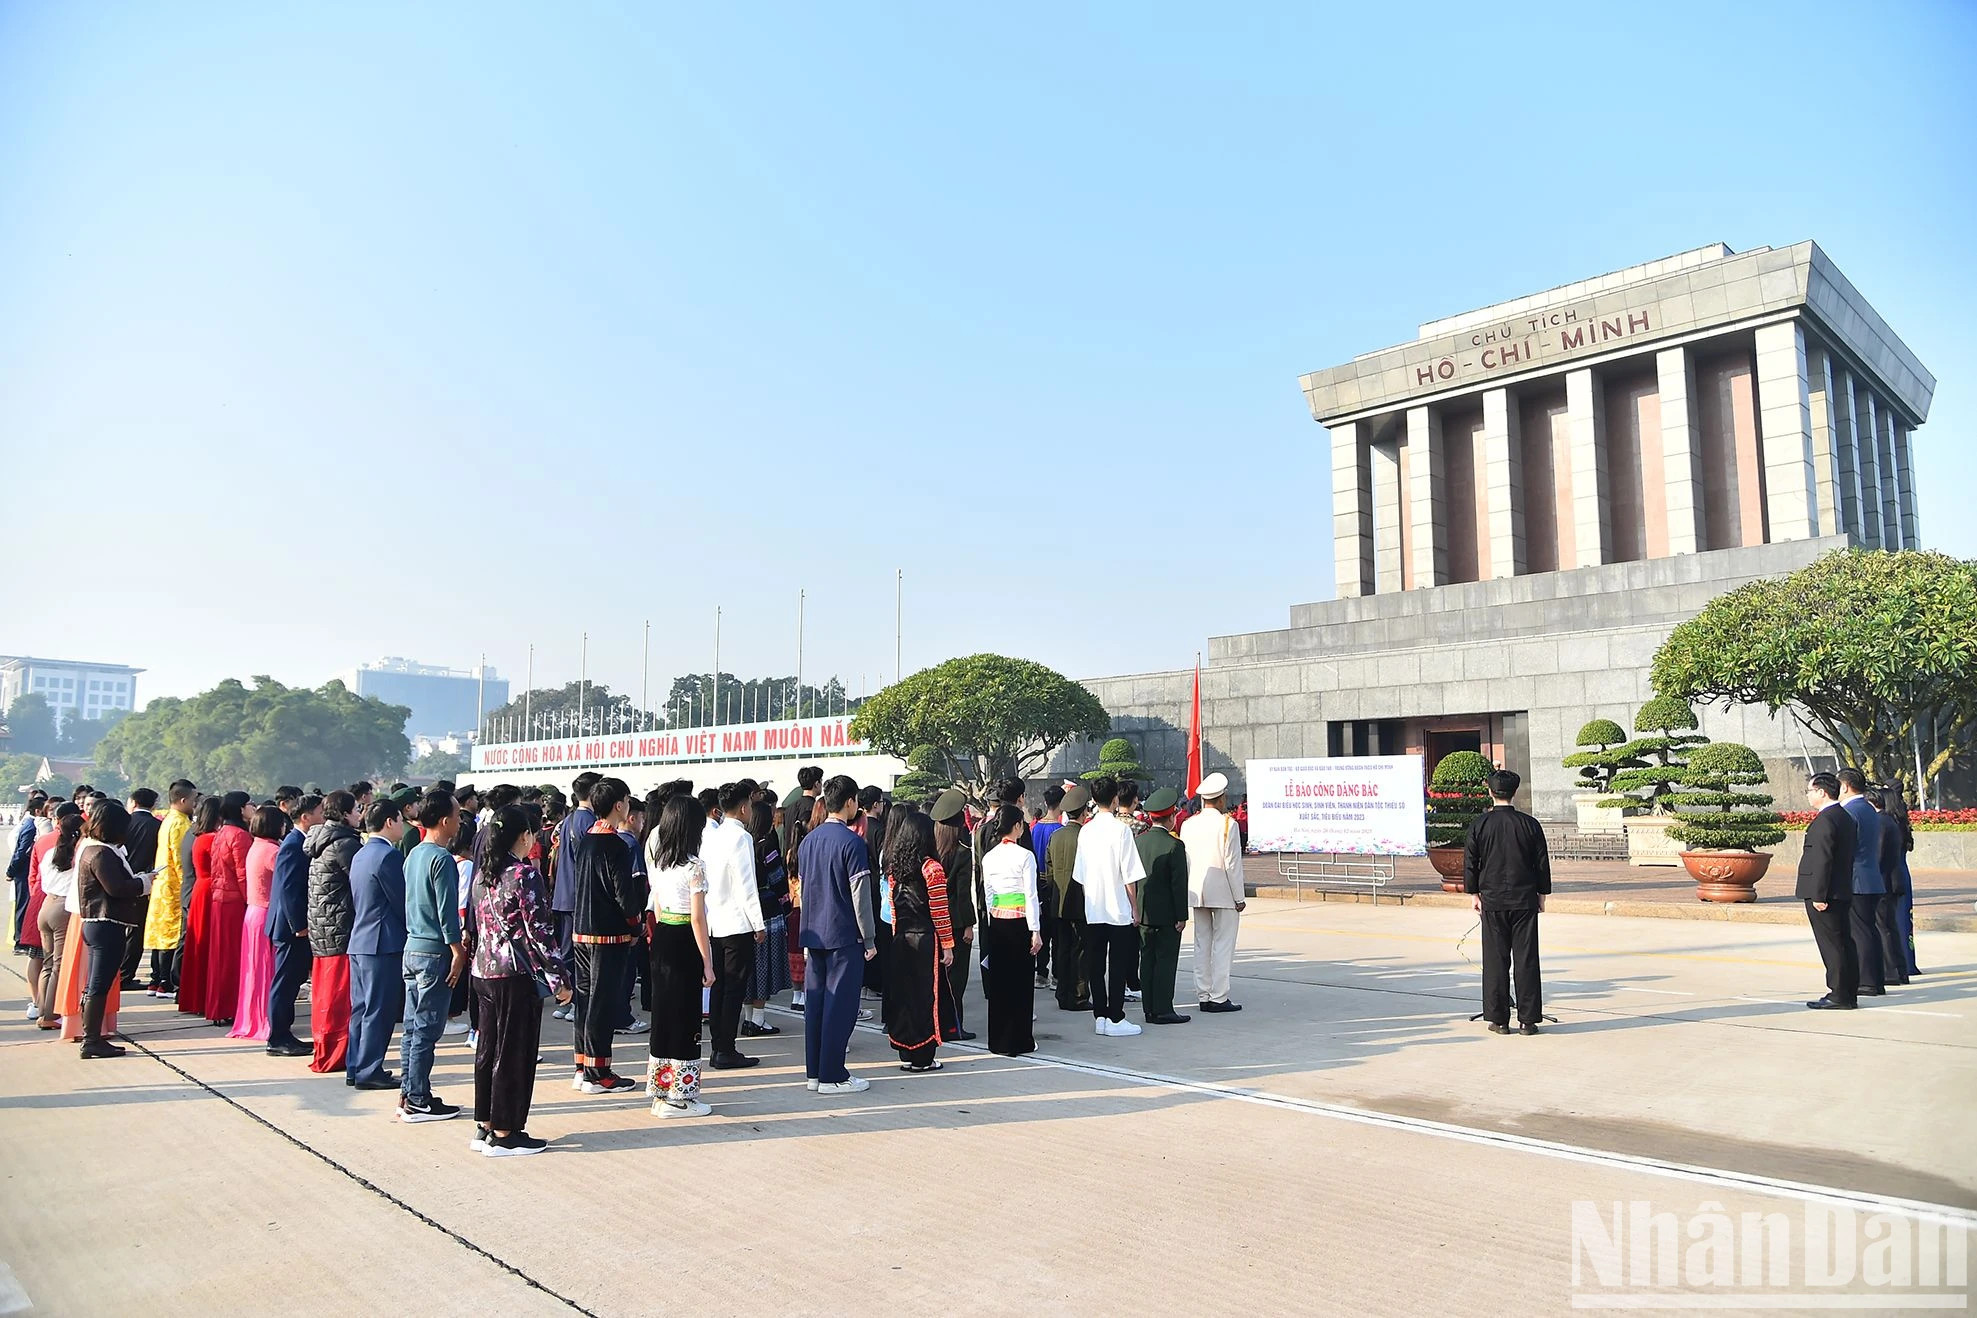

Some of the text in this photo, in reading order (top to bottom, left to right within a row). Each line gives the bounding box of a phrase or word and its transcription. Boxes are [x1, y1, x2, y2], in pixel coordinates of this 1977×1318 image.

[1471, 322, 1511, 346] CHỦ
[512, 745, 538, 766] CỘNG
[567, 741, 581, 761] XÃ
[586, 739, 605, 763] HỘI
[610, 734, 634, 758] CHỦ
[639, 733, 679, 757] NGHĨA
[685, 730, 717, 757] VIỆT
[722, 730, 757, 753] NAM
[764, 723, 813, 750] MUÔN
